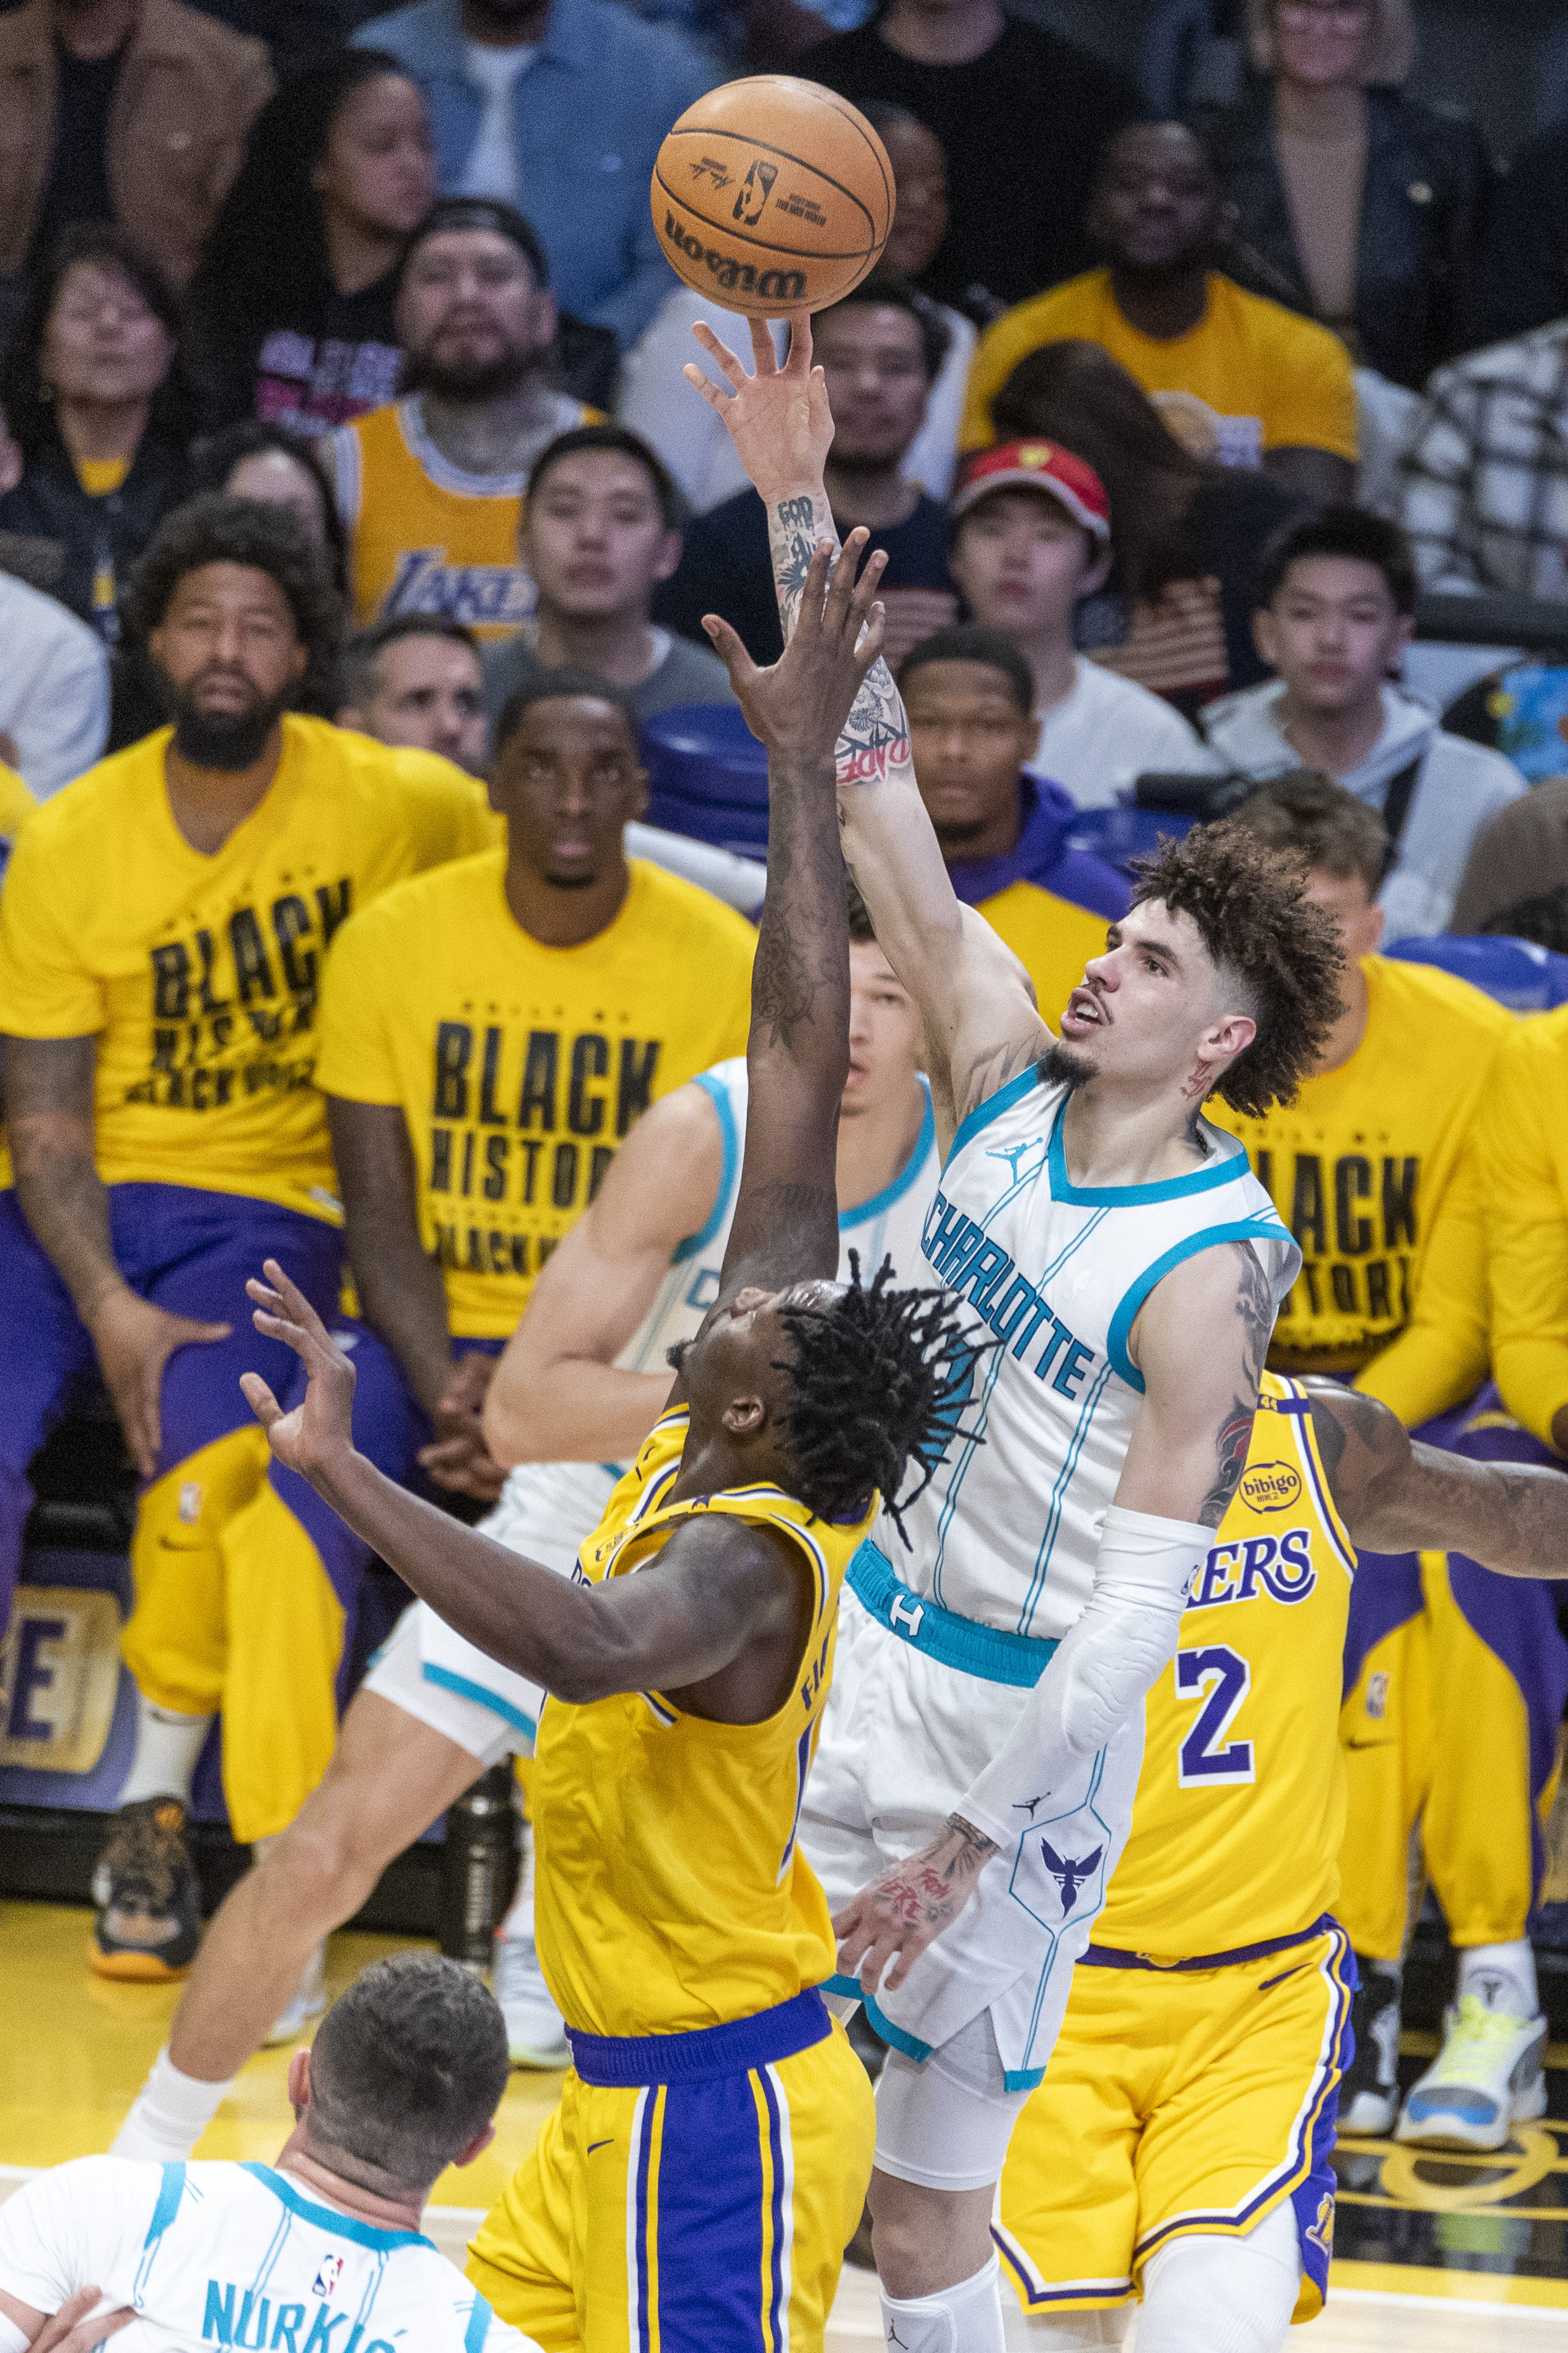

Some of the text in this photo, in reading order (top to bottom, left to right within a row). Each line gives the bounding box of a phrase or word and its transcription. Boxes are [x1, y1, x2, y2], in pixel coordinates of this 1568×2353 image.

[664, 209, 808, 301] Wilson
[433, 1020, 662, 1139] BLACK
[920, 1189, 1096, 1402] CHARLOTTE
[1243, 1475, 1297, 1496] bibigo
[1184, 1528, 1318, 1611] ERS
[1175, 1643, 1257, 1789] 2
